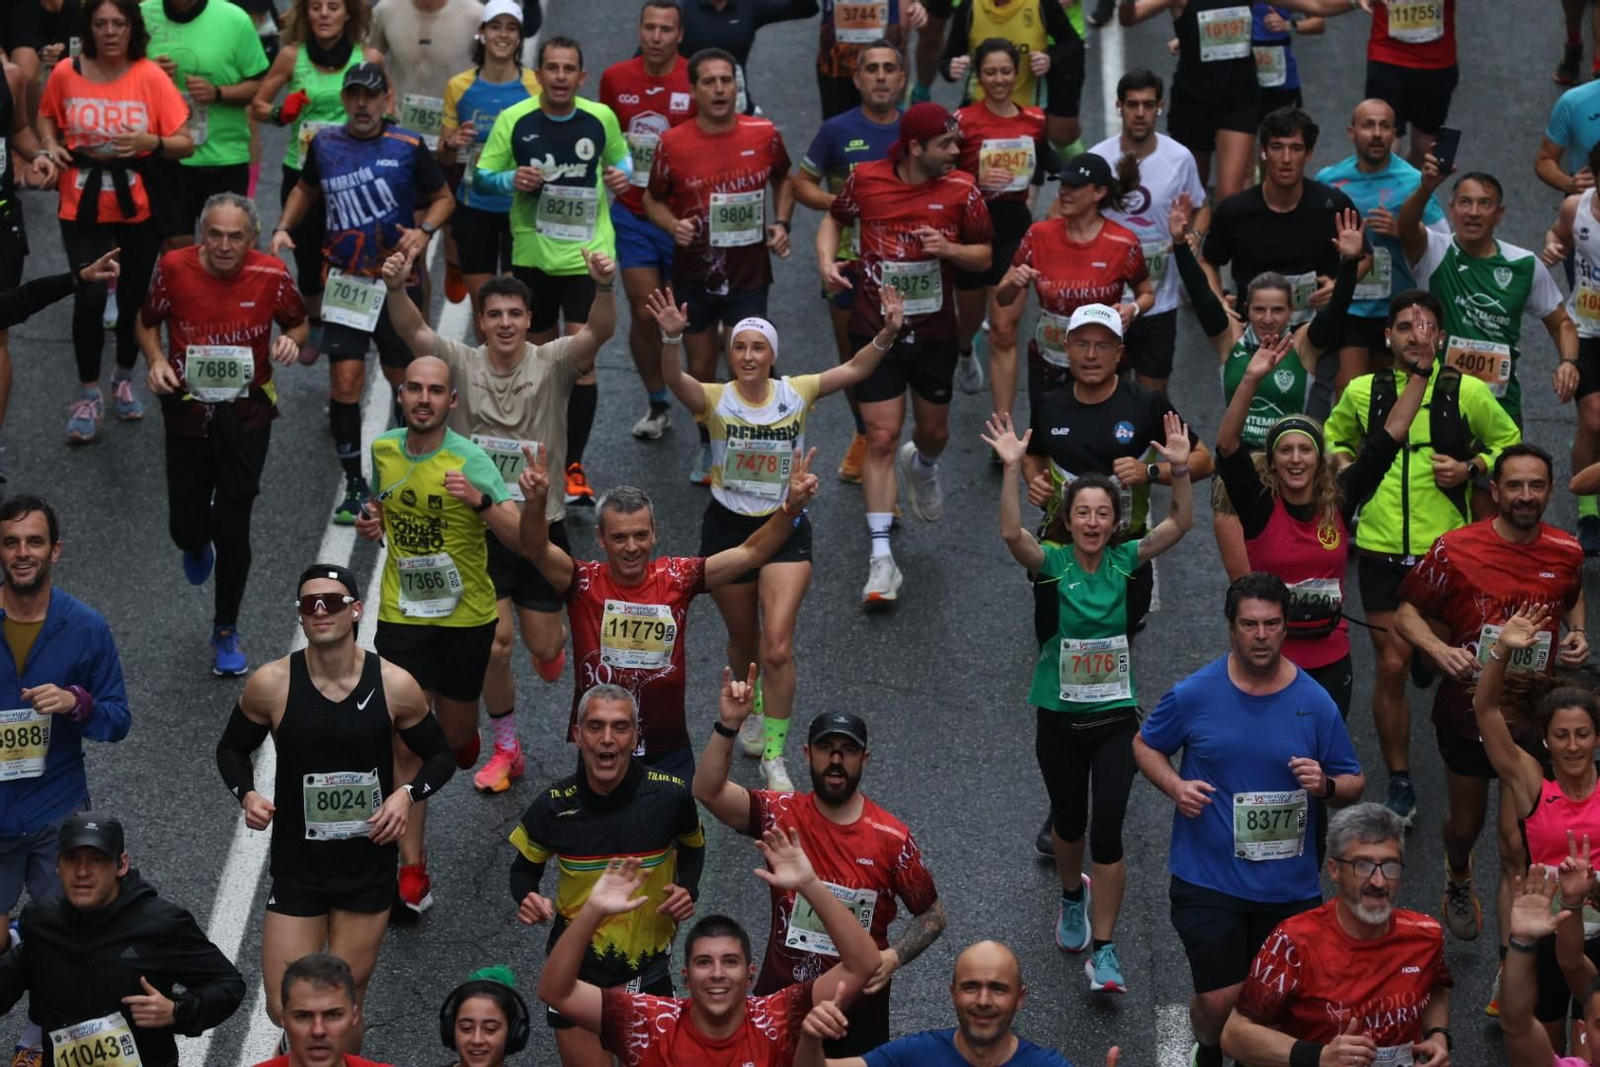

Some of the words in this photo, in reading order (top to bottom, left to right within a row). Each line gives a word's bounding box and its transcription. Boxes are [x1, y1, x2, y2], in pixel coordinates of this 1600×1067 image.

[843, 7, 876, 21] 3744
[1395, 4, 1434, 21] 11755
[985, 150, 1028, 168] 12947
[546, 198, 584, 217] 8215
[719, 206, 753, 223] 9804
[332, 282, 368, 304] 7011
[196, 361, 238, 378] 7688
[1455, 352, 1495, 373] 4001
[735, 453, 778, 474] 7478
[404, 571, 446, 592] 7366
[609, 617, 666, 641] 11779
[1071, 652, 1115, 674] 7176
[316, 788, 367, 811] 8024
[1246, 809, 1293, 831] 8377
[856, 857, 874, 866] HOKA
[60, 1035, 121, 1067] 11043
